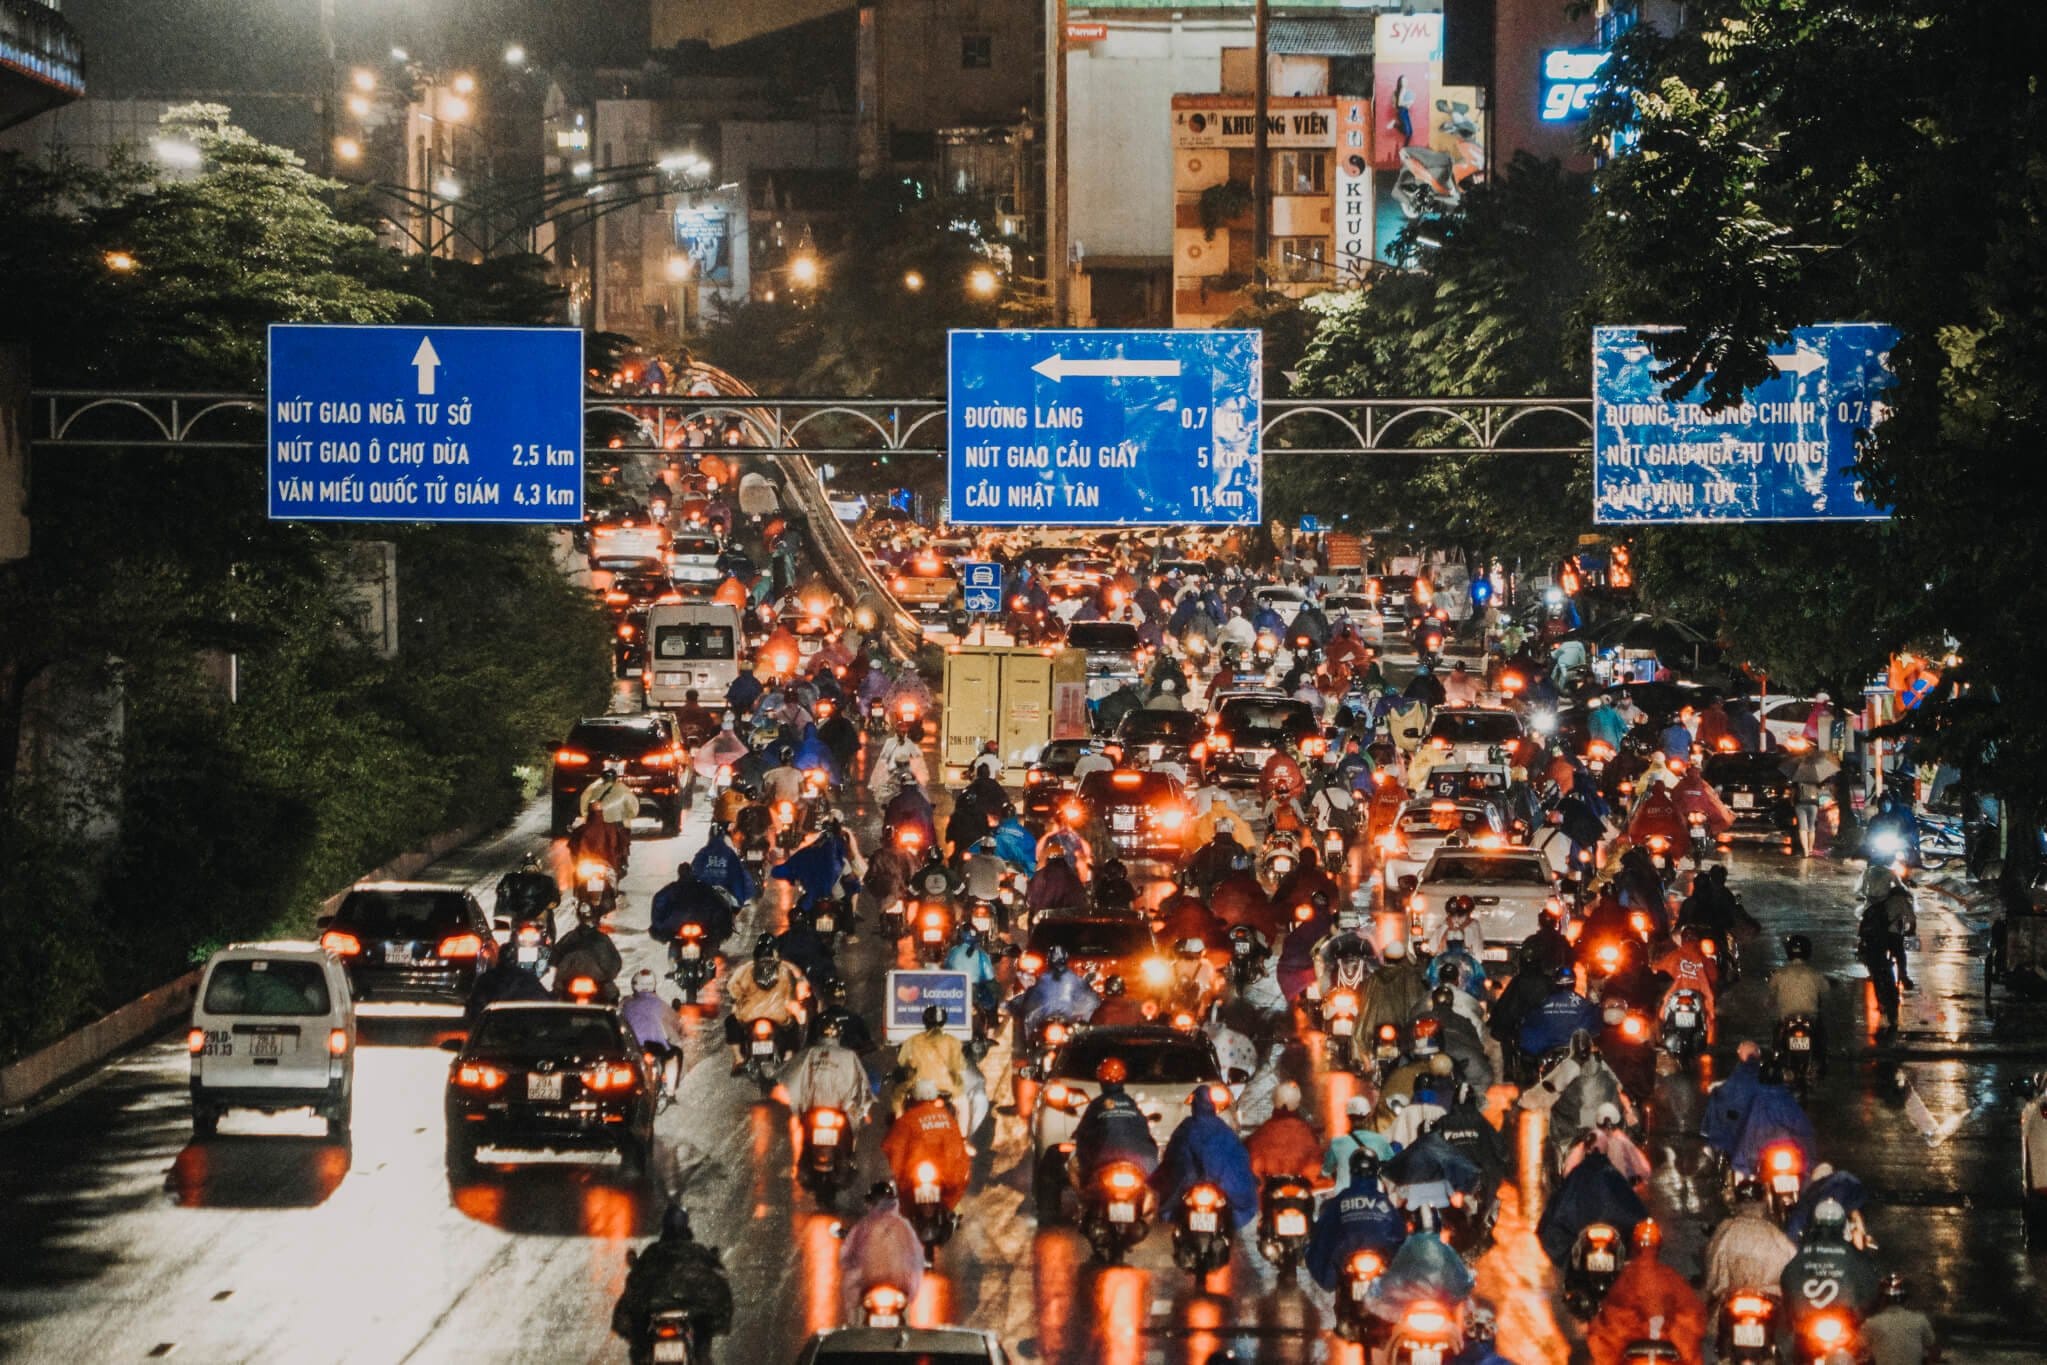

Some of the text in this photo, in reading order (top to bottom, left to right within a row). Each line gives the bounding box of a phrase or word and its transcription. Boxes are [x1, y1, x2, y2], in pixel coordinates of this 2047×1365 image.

[1390, 21, 1431, 44] SYM
[1222, 115, 1286, 135] KHƯNG
[1293, 111, 1329, 135] VIÊN
[277, 395, 472, 425] NÚT GIAO NGÃ TƯ SỞ
[964, 400, 1028, 429] ĐƯỜNG
[1035, 400, 1083, 429] LÁNG
[1181, 406, 1208, 430] 0.7
[1759, 402, 1815, 424] CHINH
[1838, 401, 1864, 424] 0.7
[277, 435, 313, 463] NÚT
[320, 441, 361, 463] GIAO
[369, 438, 381, 464] Ô
[388, 441, 425, 468] CHỢ
[433, 436, 470, 465] DỪA
[547, 444, 574, 466] km
[965, 440, 1001, 468] NÚT
[1007, 446, 1049, 468] GIAO
[1099, 439, 1139, 468] GIẤY
[1197, 447, 1209, 469] 5
[1648, 443, 1691, 466] GIAO
[278, 476, 314, 502] VĂN
[320, 473, 364, 503] MIẾU
[369, 474, 418, 504] QUỐC
[424, 475, 447, 504] TỬ
[454, 477, 499, 504] GIÁM
[547, 484, 574, 506] km
[1008, 482, 1055, 511] NHẬT
[1065, 482, 1099, 507] TÂN
[1190, 486, 1209, 507] 11
[1214, 486, 1244, 507] km
[923, 987, 964, 999] Lazada
[1340, 1196, 1377, 1213] BIDV
